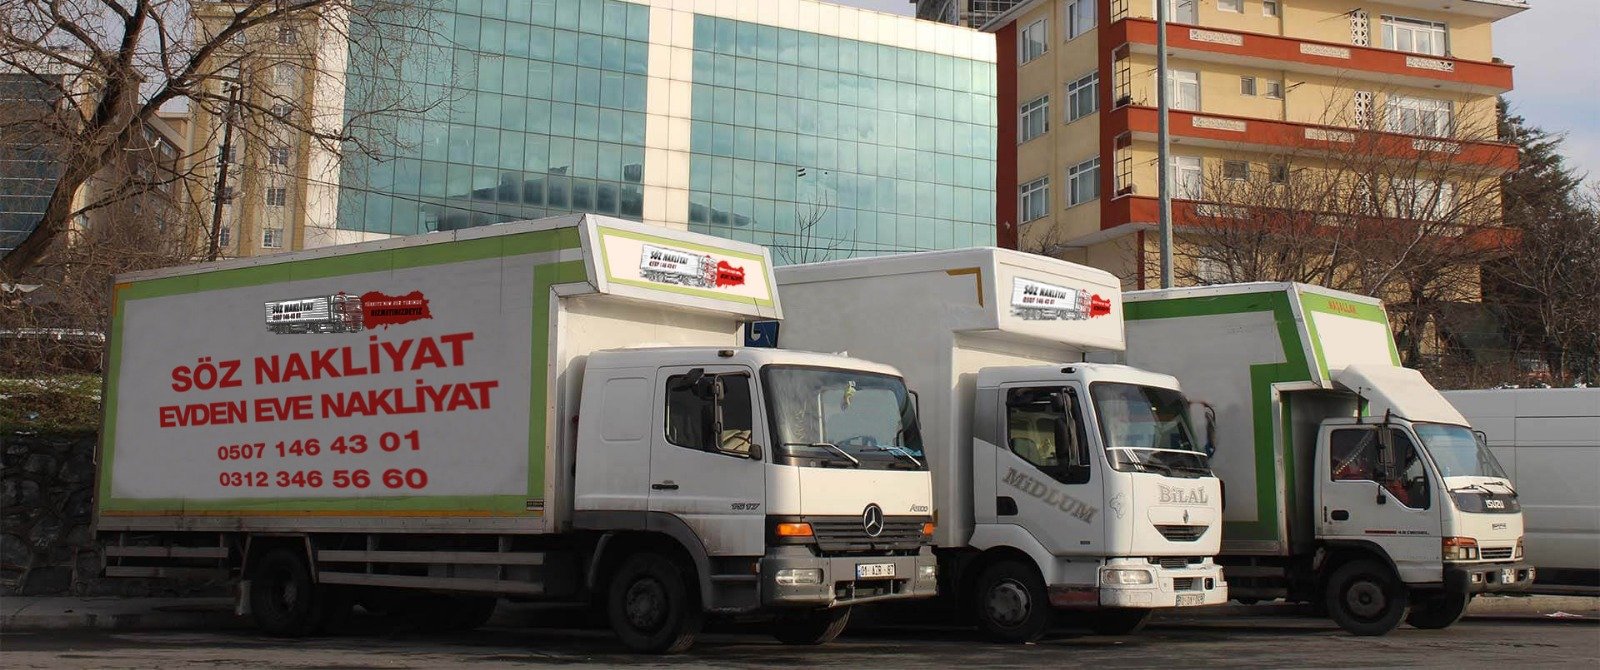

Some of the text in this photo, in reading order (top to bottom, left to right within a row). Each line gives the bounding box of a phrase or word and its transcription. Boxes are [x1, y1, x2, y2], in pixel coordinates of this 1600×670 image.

[171, 332, 475, 393] SÖZ NAKLİYAT
[159, 380, 499, 428] EVDEN EVE NAKLİYAT
[217, 430, 420, 461] 0507 146 43 01
[219, 468, 429, 490] 0312 346 56 60
[1485, 499, 1505, 508] ISUZU
